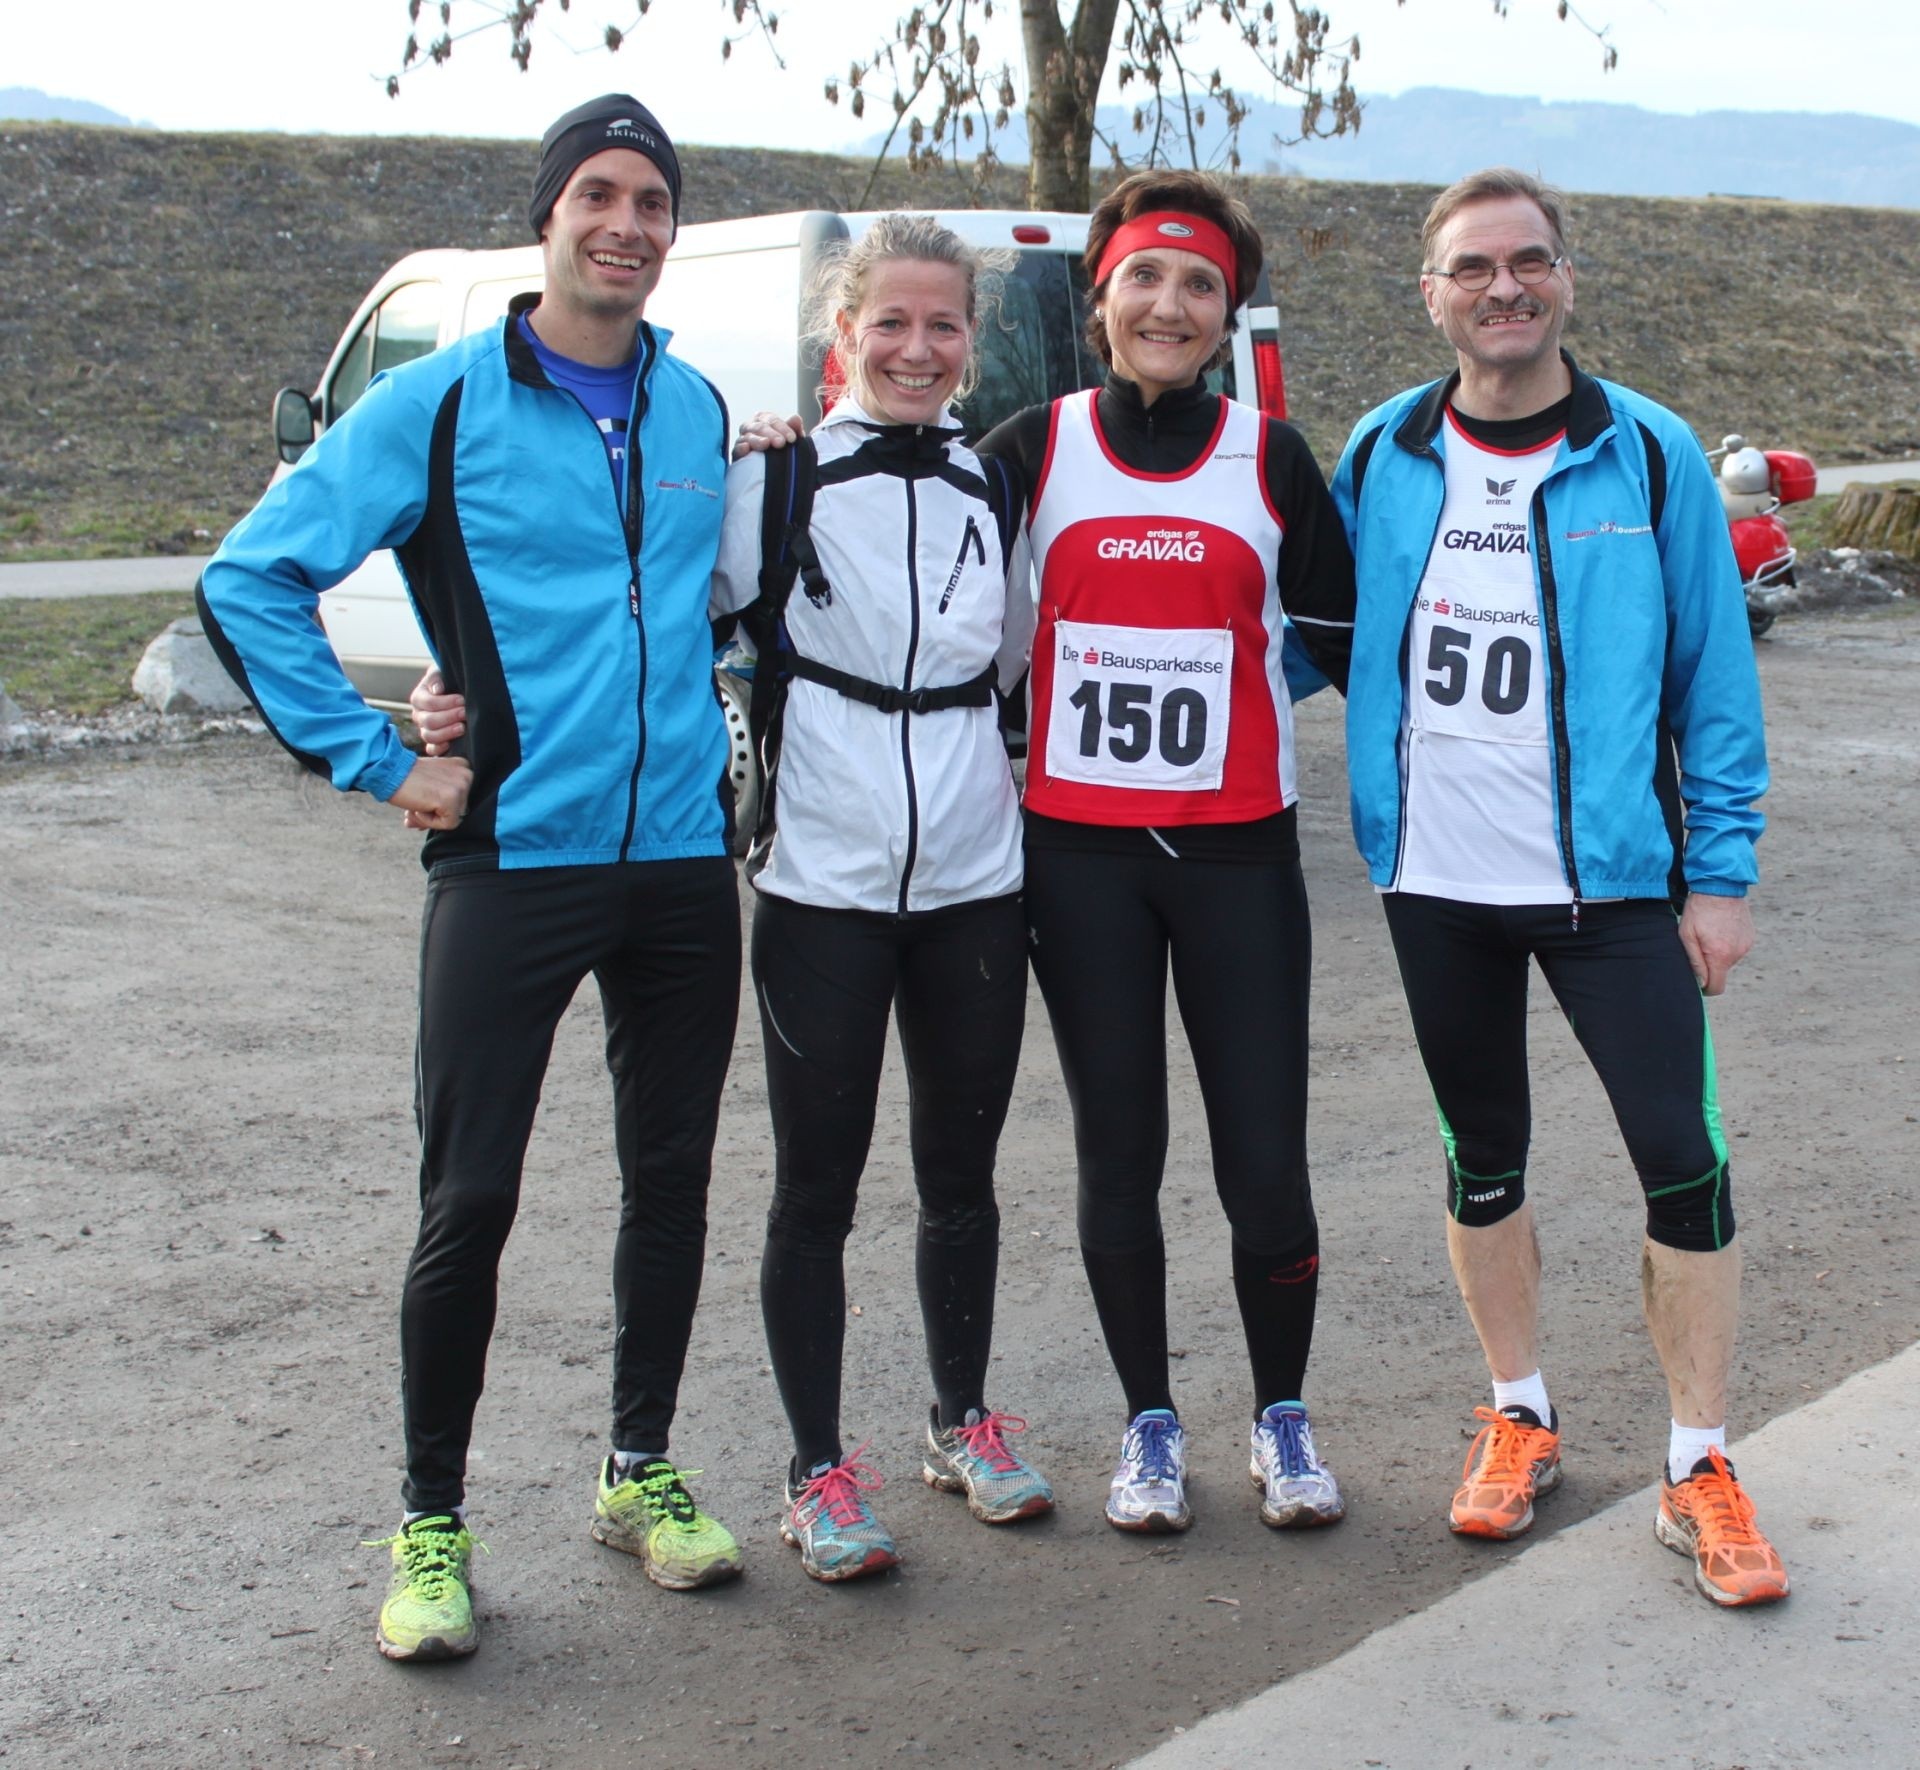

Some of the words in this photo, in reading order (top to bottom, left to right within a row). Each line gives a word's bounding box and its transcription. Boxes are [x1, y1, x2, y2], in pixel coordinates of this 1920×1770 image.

[606, 128, 656, 149] skinfit
[1147, 529, 1183, 540] erdgas
[1492, 522, 1526, 532] erdgas
[1097, 538, 1205, 563] GRAVAG
[1443, 529, 1530, 554] GRAVA
[1101, 651, 1224, 674] Bausparkasse
[1424, 625, 1532, 715] 50
[1069, 679, 1208, 767] 150
